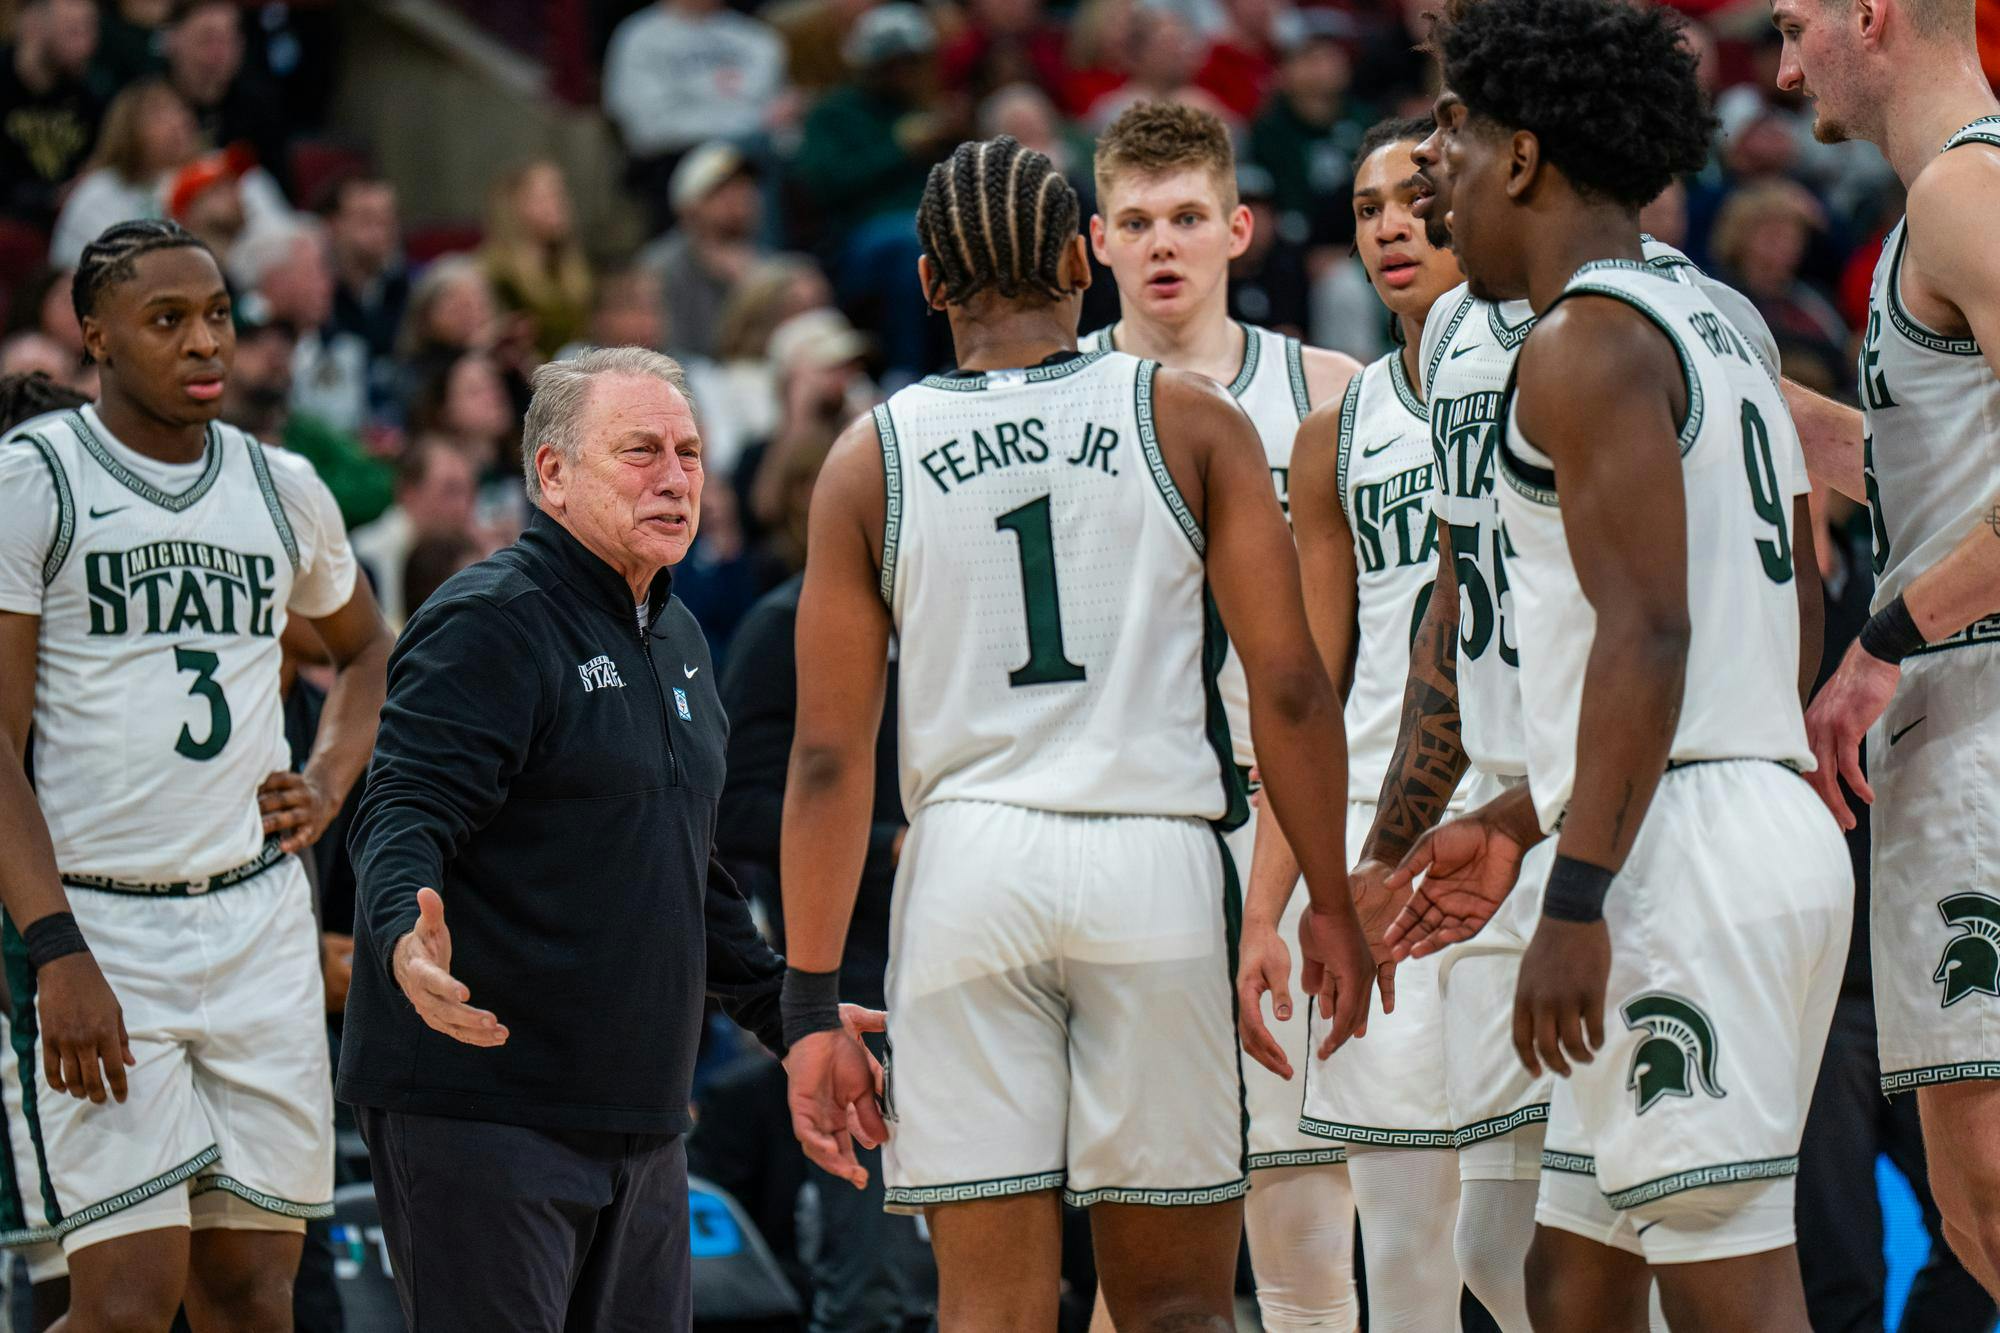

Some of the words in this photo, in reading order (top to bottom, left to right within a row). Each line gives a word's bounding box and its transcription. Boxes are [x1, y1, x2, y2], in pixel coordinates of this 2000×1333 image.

[1432, 398, 1498, 498] STA
[1452, 393, 1501, 428] MICH
[919, 418, 1050, 495] FEARS
[1066, 422, 1120, 478] JR.
[1385, 464, 1435, 505] MIC
[1741, 398, 1793, 585] 9
[129, 541, 243, 577] MICHIGAN
[1355, 484, 1440, 573] STA
[85, 551, 276, 637] STATE
[994, 493, 1087, 688] 1
[173, 644, 232, 762] 3
